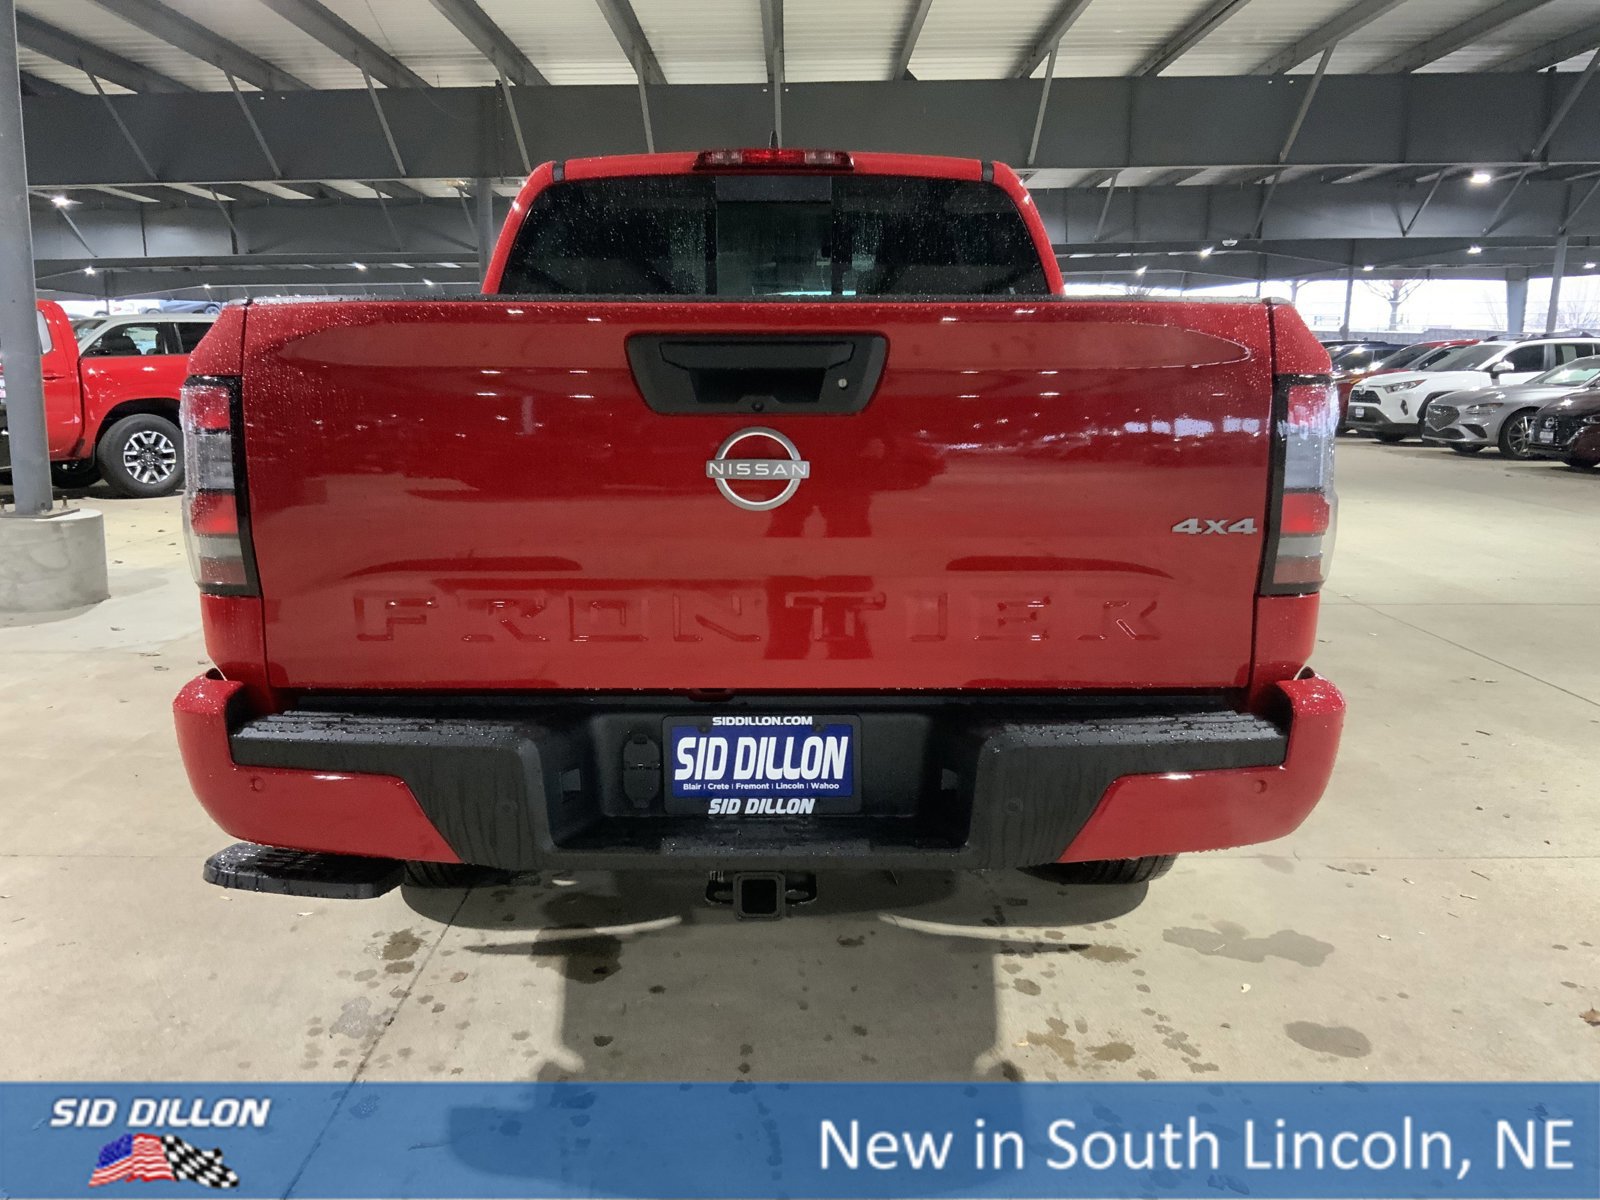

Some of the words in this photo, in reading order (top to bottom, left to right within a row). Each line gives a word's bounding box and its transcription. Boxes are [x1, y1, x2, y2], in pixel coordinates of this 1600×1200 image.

[709, 462, 806, 476] NISSAN
[353, 593, 1161, 642] FRONTIER
[712, 716, 813, 726] SIDDILLON.COM
[674, 737, 729, 781] SID
[733, 736, 848, 780] DILLON
[775, 782, 804, 790] Lincoln
[811, 782, 840, 790] Wahoo
[708, 798, 741, 815] SID
[744, 798, 815, 815] DILLON
